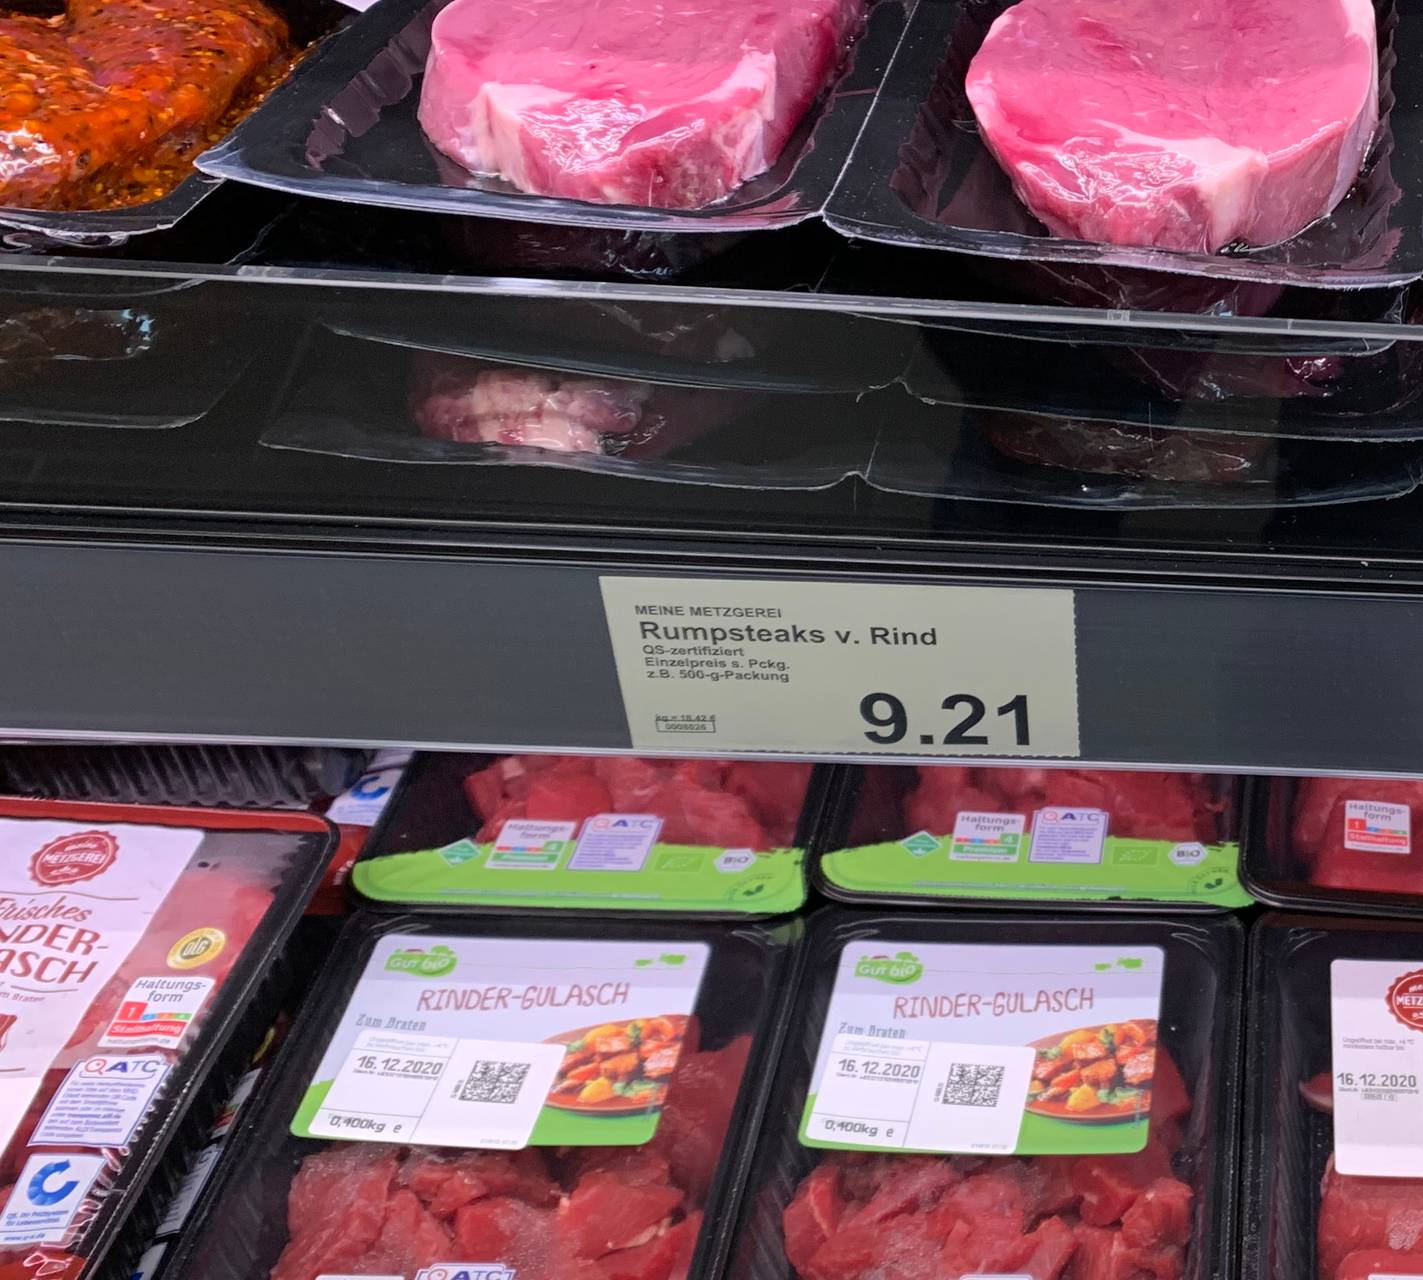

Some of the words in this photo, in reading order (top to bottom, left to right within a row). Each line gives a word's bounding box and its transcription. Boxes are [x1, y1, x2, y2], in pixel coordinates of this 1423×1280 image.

[635, 605, 684, 616] MEINE
[690, 607, 782, 618] METZGEREI
[639, 621, 826, 645] Rumpsteaks
[836, 630, 860, 644] v.
[872, 627, 937, 645] Rind
[642, 645, 744, 656] QS-zertifiziert
[645, 657, 727, 669] Einzelpreis
[749, 659, 790, 671] Pckg.
[647, 670, 674, 679] z.B.
[680, 670, 790, 683] 500-g-Packung
[859, 692, 1031, 746] 9.21
[1349, 803, 1406, 815] Haltungs-
[1364, 811, 1392, 821] form
[975, 823, 1004, 831] form
[43, 851, 105, 864] METZGEREI
[1177, 849, 1200, 858] BIO
[135, 979, 206, 992] Haltungs-
[147, 991, 184, 1002] form
[417, 982, 630, 1012] RINDER-GULASCH
[893, 988, 1094, 1019] RINDER-GULASCH
[128, 1006, 137, 1018] 1
[355, 1013, 382, 1028] Zum
[384, 1016, 426, 1031] Braten
[838, 1022, 864, 1034] Zum
[869, 1024, 906, 1038] Braten
